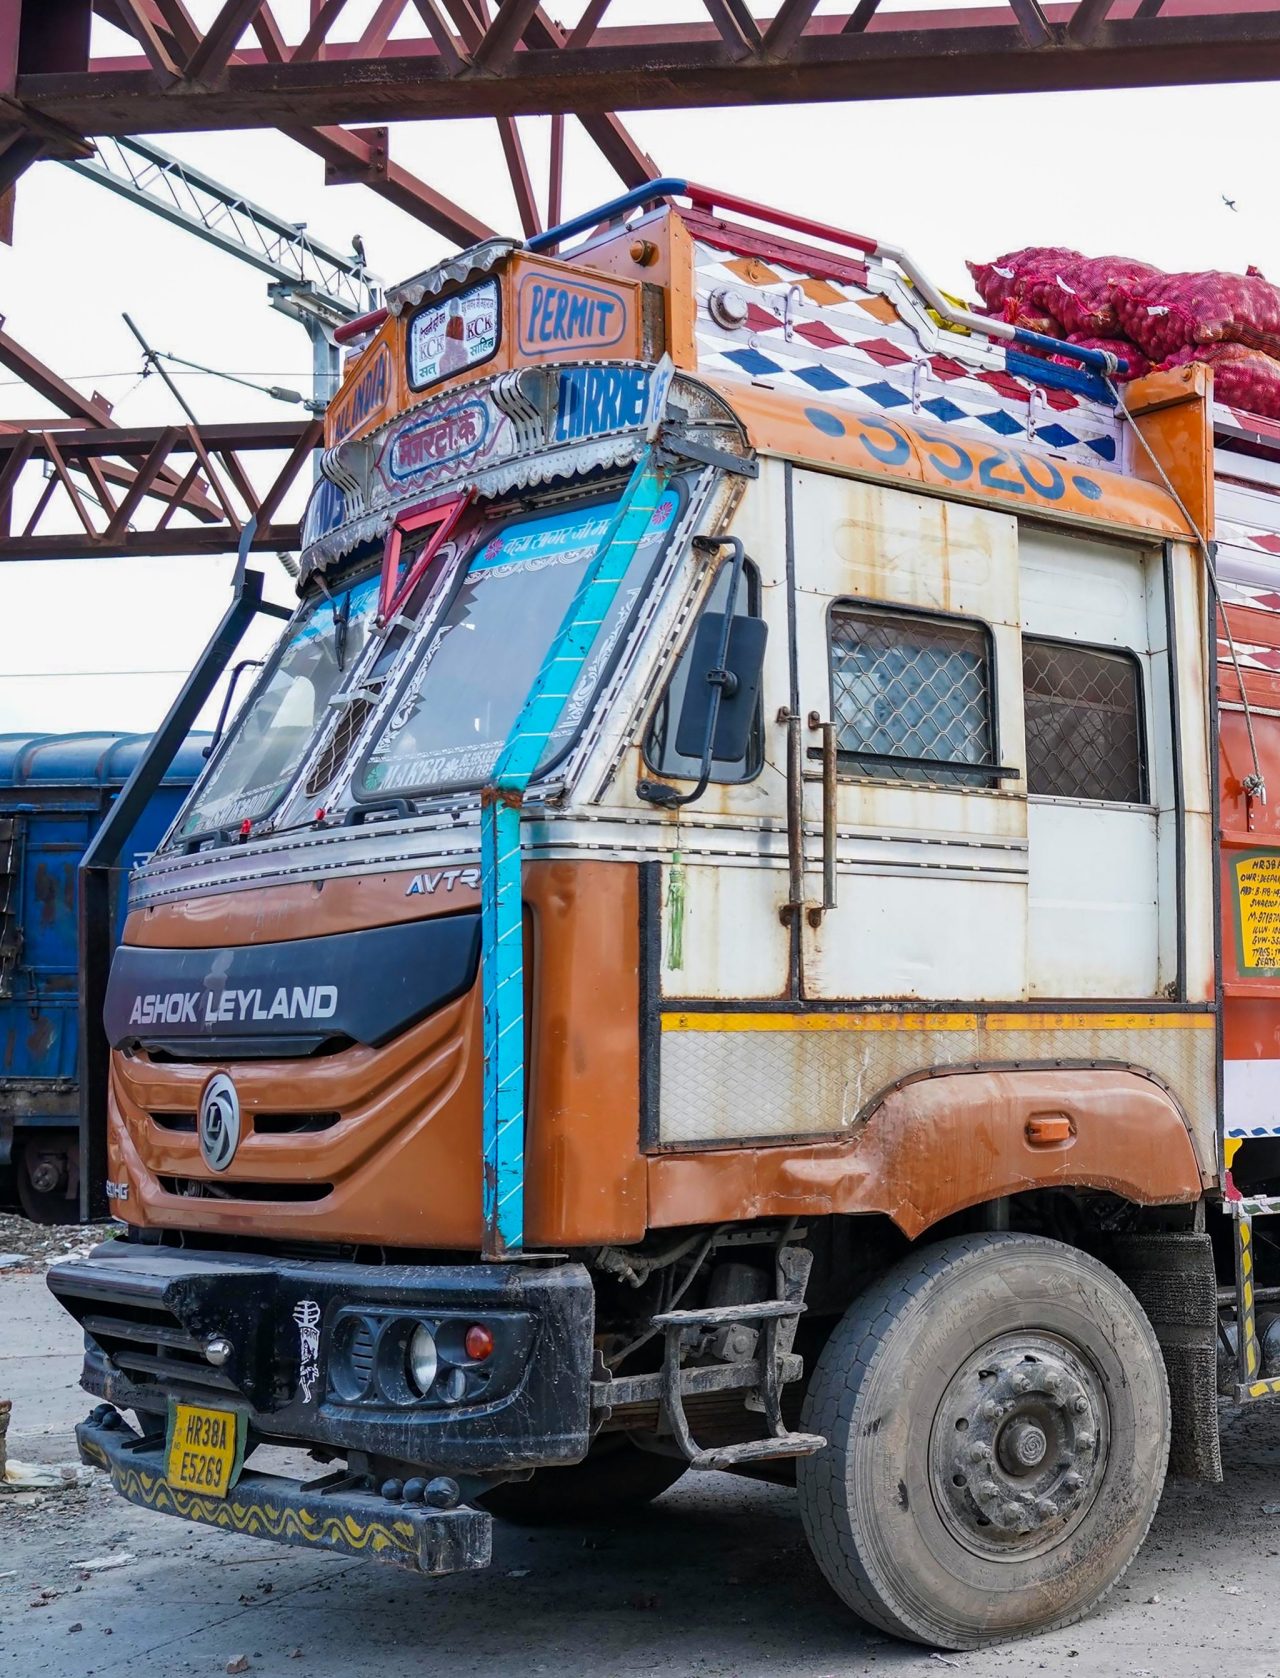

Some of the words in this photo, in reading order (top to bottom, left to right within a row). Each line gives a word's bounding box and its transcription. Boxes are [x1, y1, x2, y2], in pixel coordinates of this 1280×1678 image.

[528, 285, 615, 343] PERMIT
[556, 368, 651, 441] CARRIE
[404, 867, 482, 897] AVTR
[129, 992, 200, 1025] ASHOK
[204, 985, 338, 1022] LEYLAND
[186, 1414, 228, 1450] HR38A
[180, 1451, 223, 1488] E5269
